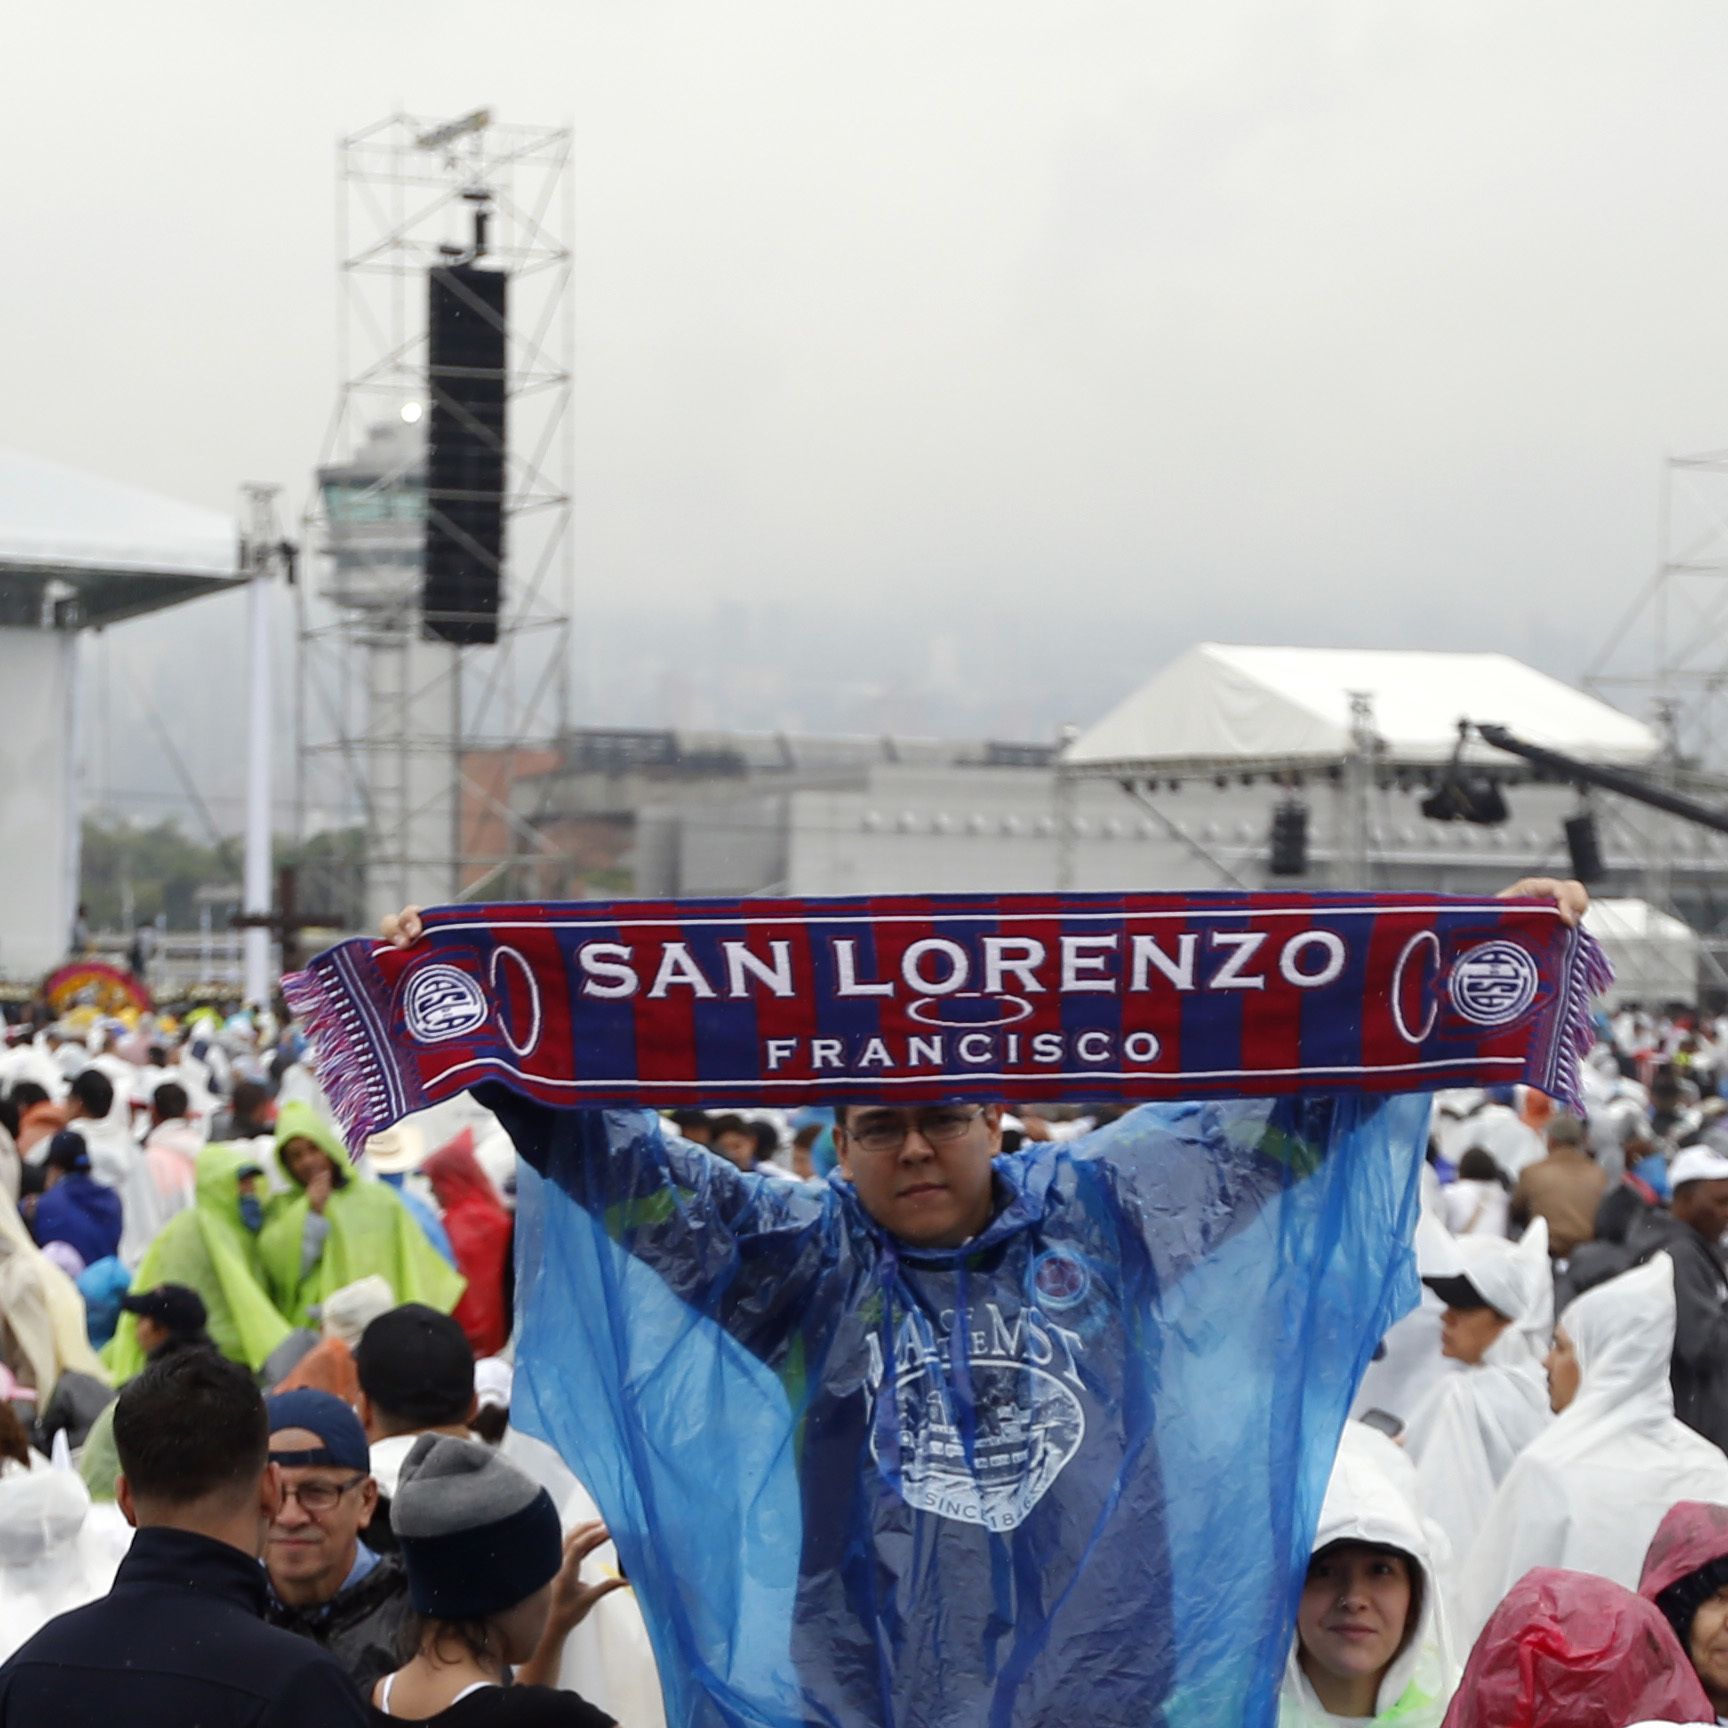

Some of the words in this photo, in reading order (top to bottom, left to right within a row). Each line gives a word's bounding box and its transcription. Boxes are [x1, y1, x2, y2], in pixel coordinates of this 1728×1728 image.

[578, 940, 795, 998] SAN
[832, 930, 1346, 997] LORENZO
[766, 1032, 1160, 1069] FRANCISCO
[936, 1330, 988, 1360] TE
[985, 1303, 1087, 1392] MST
